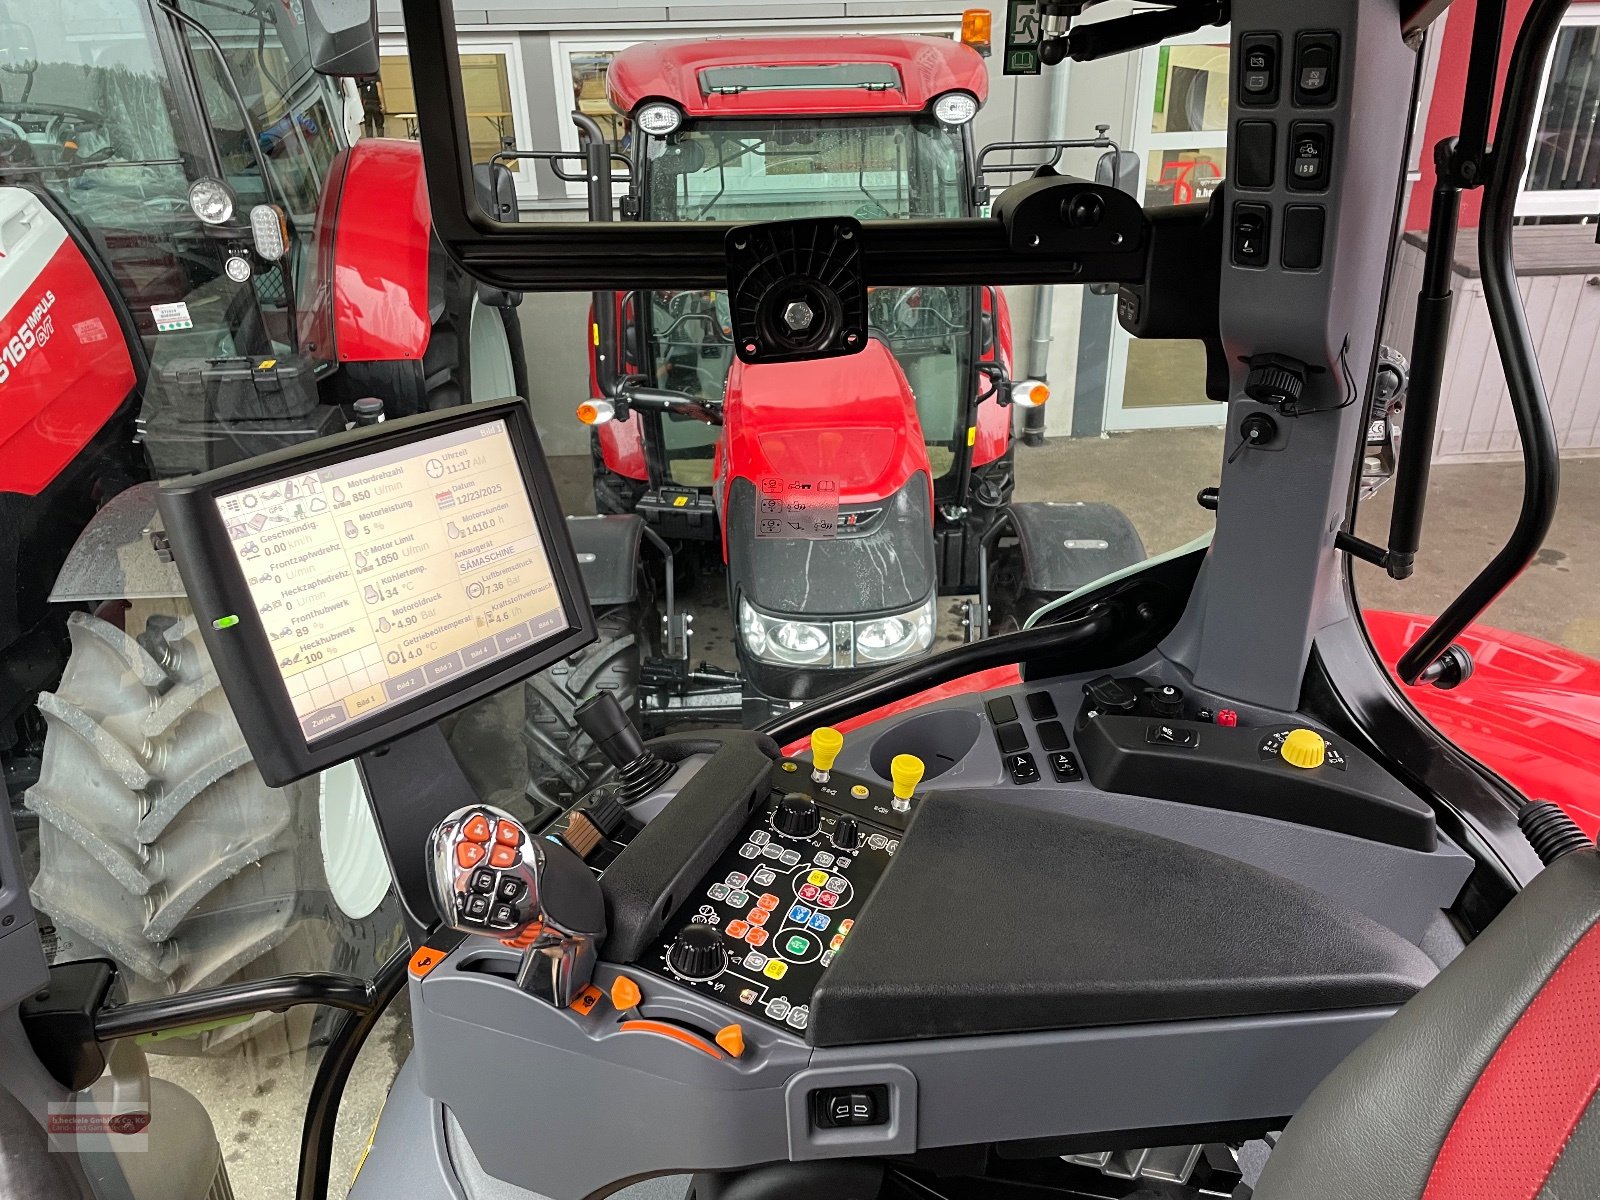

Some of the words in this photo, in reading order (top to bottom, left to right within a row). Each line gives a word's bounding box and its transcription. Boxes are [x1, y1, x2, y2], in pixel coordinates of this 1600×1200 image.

[26, 290, 56, 330] IMPULS
[442, 448, 468, 461] Uhrzeit
[446, 459, 471, 475] 11:17
[472, 455, 487, 467] AM
[347, 466, 404, 488] Motordrehzahl
[452, 480, 475, 493] Datum
[352, 490, 371, 502] 850
[374, 481, 403, 496] U/min
[456, 484, 502, 505] 12/23/2025
[268, 505, 283, 514] GPS
[359, 500, 413, 521] Motorleistung
[462, 502, 509, 523] Motorstunden
[259, 521, 318, 543] Geschwindig.
[363, 525, 371, 535] 5
[467, 518, 496, 536] 1410.0
[498, 515, 505, 524] h
[264, 543, 287, 557] 0.00
[288, 535, 313, 550] km/h
[370, 541, 393, 554] Motor
[394, 533, 415, 546] Limit
[454, 540, 493, 559] Anbaugerät
[374, 551, 399, 567] 1850
[401, 542, 430, 557] U/min
[459, 545, 515, 572] SÄMASCHINE
[274, 575, 282, 584] 0
[286, 564, 316, 579] U/min
[381, 565, 427, 585] Kühlertemp.
[481, 558, 534, 582] Luftbremsdruck
[385, 587, 399, 598] 34
[485, 582, 504, 595] 7.36
[506, 575, 521, 586] Bar
[286, 601, 293, 611] 0
[296, 591, 326, 607] U/min
[391, 593, 442, 617] Motoröldruck
[491, 582, 553, 612] Kraftstoffverbrauch
[291, 600, 350, 625] Fronthubwerk
[397, 615, 418, 629] 4.90
[420, 608, 437, 621] Bar
[495, 611, 510, 623] 4.6
[295, 626, 309, 637] 89
[300, 626, 356, 652] Heckhubwerk
[305, 651, 323, 665] 100
[408, 649, 423, 660] 4.0
[434, 664, 448, 674] Bild
[396, 681, 409, 691] Bild
[356, 697, 371, 708] Bild
[312, 713, 337, 728] Zurück
